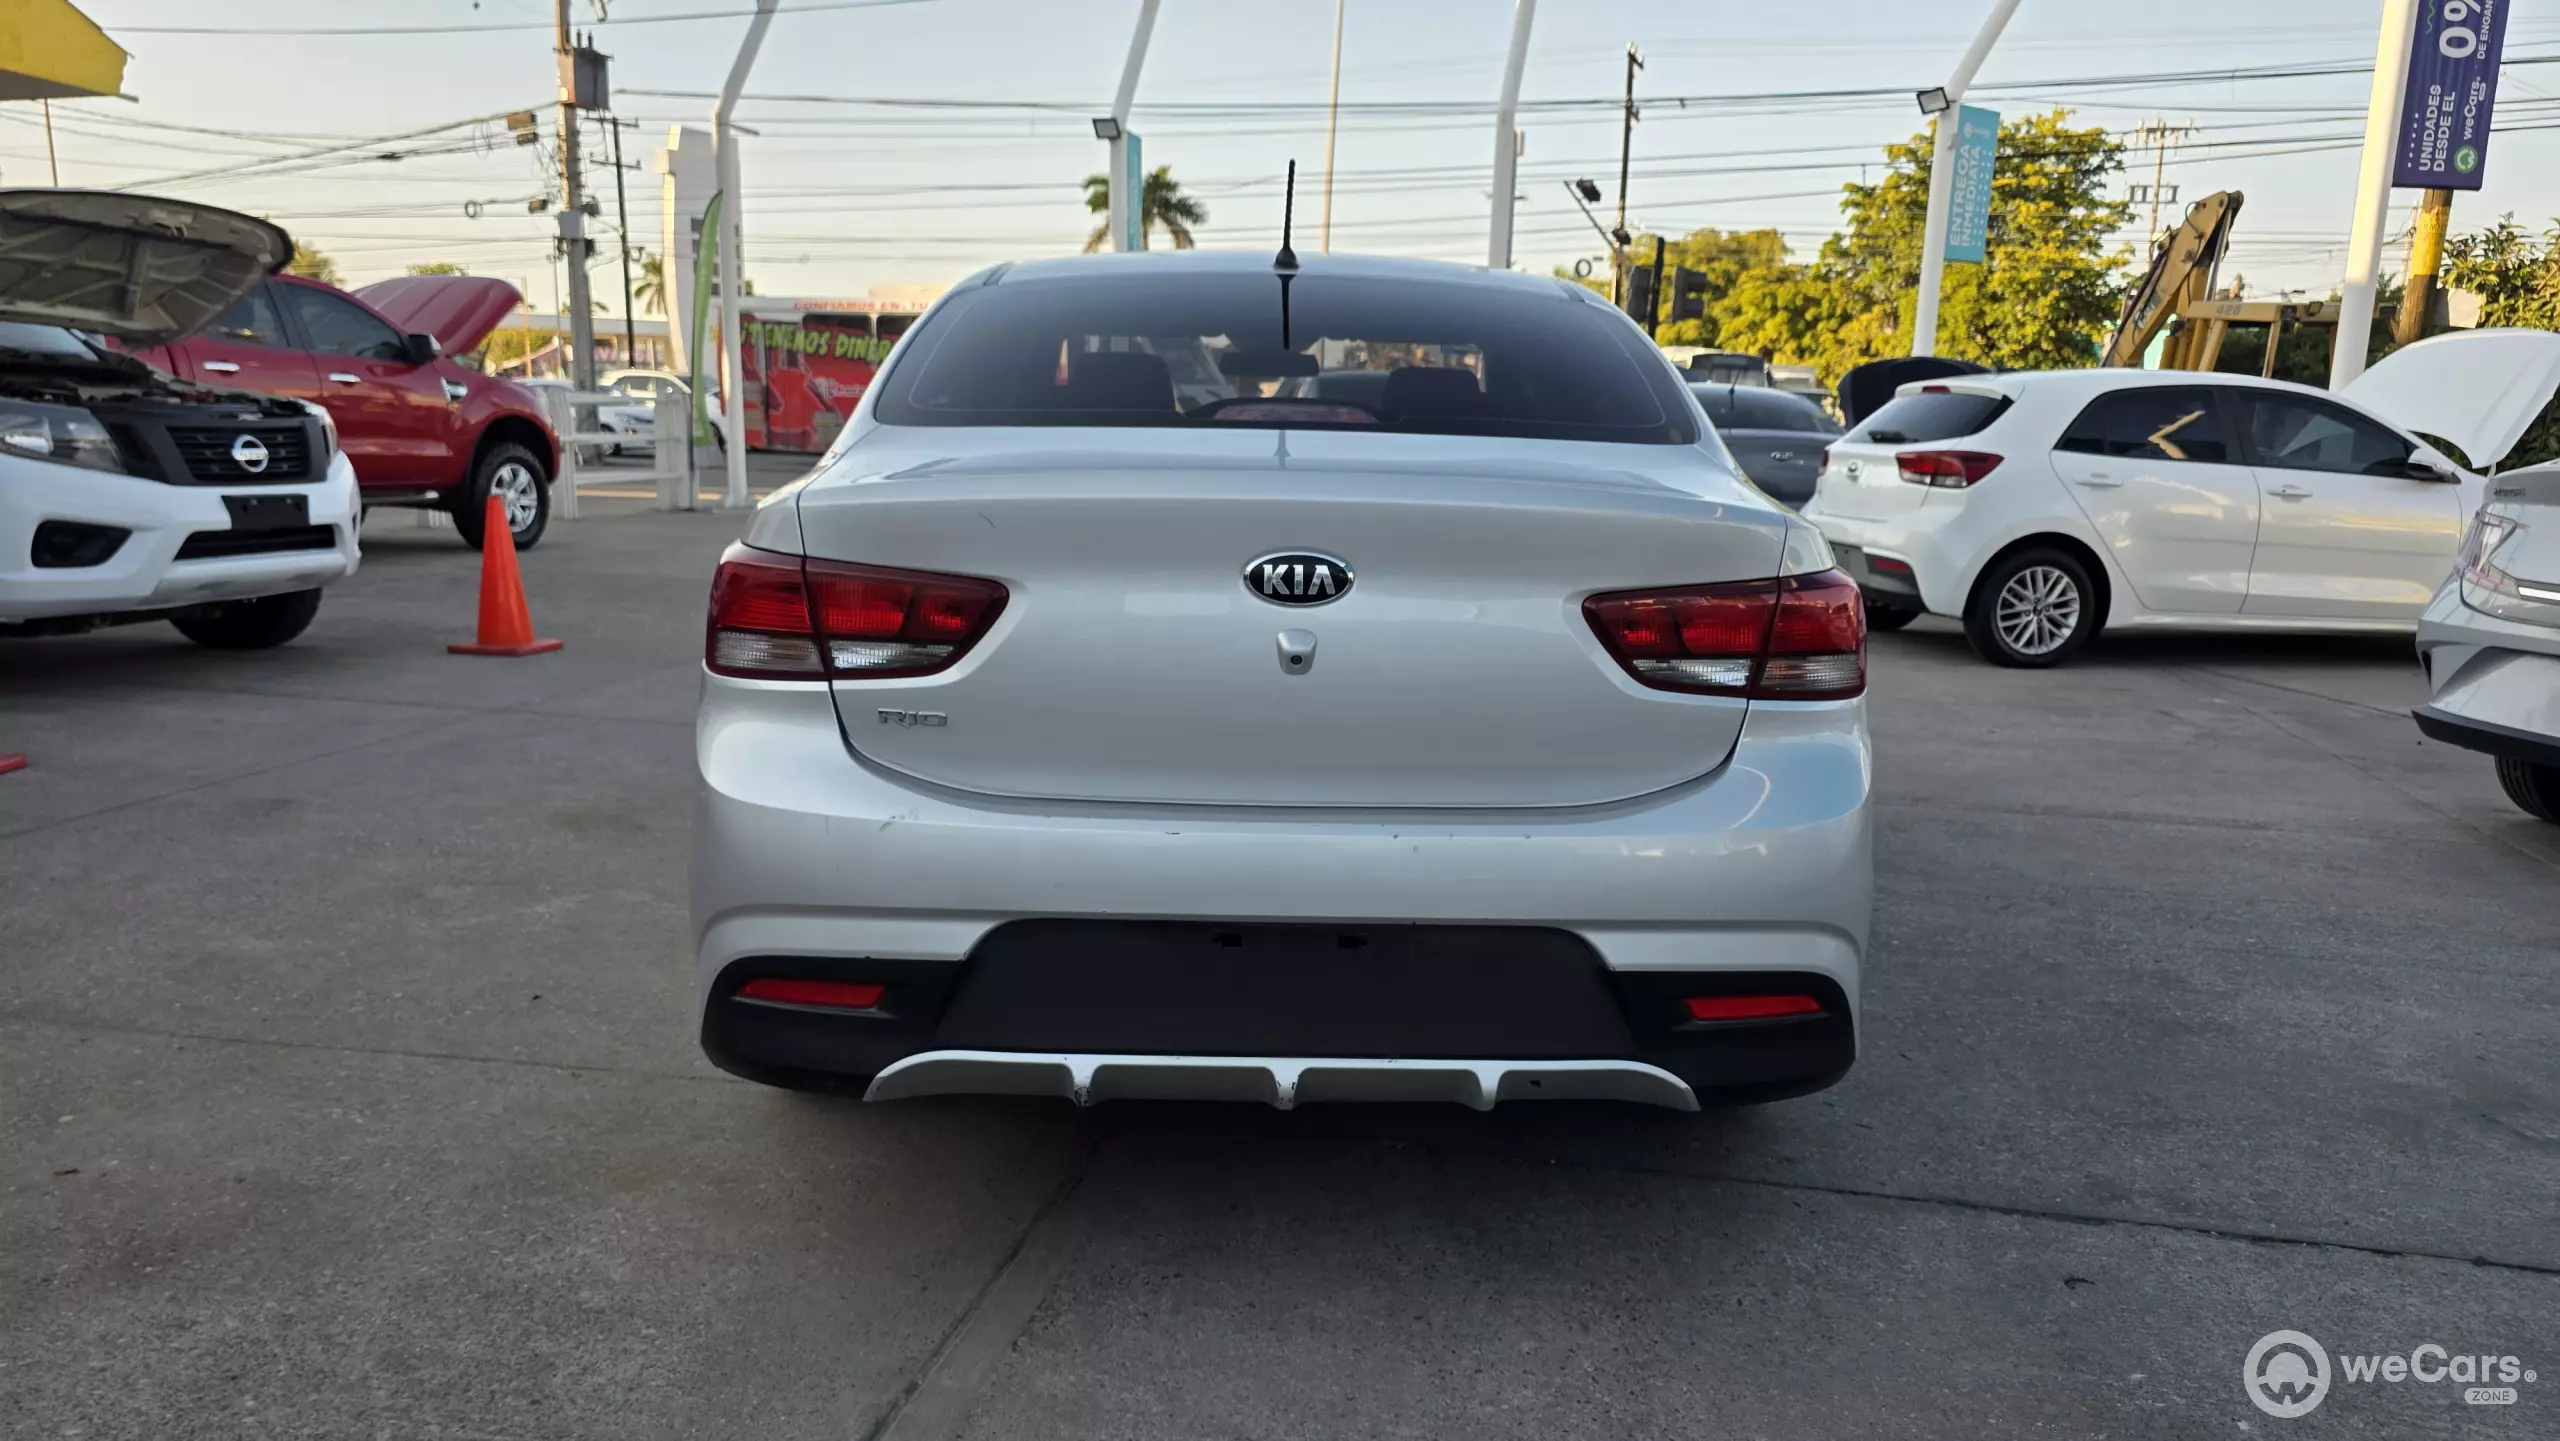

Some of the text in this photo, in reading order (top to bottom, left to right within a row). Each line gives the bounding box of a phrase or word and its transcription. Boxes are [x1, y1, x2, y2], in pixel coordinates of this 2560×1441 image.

[2477, 42, 2487, 60] DE
[2419, 84, 2442, 171] UNIDADES
[2433, 91, 2456, 172] DESDE EL
[1949, 143, 1972, 246] ENTREGA
[1961, 145, 1982, 248] INMEDIATA
[1263, 564, 1336, 595] KIA
[877, 707, 948, 729] RIO
